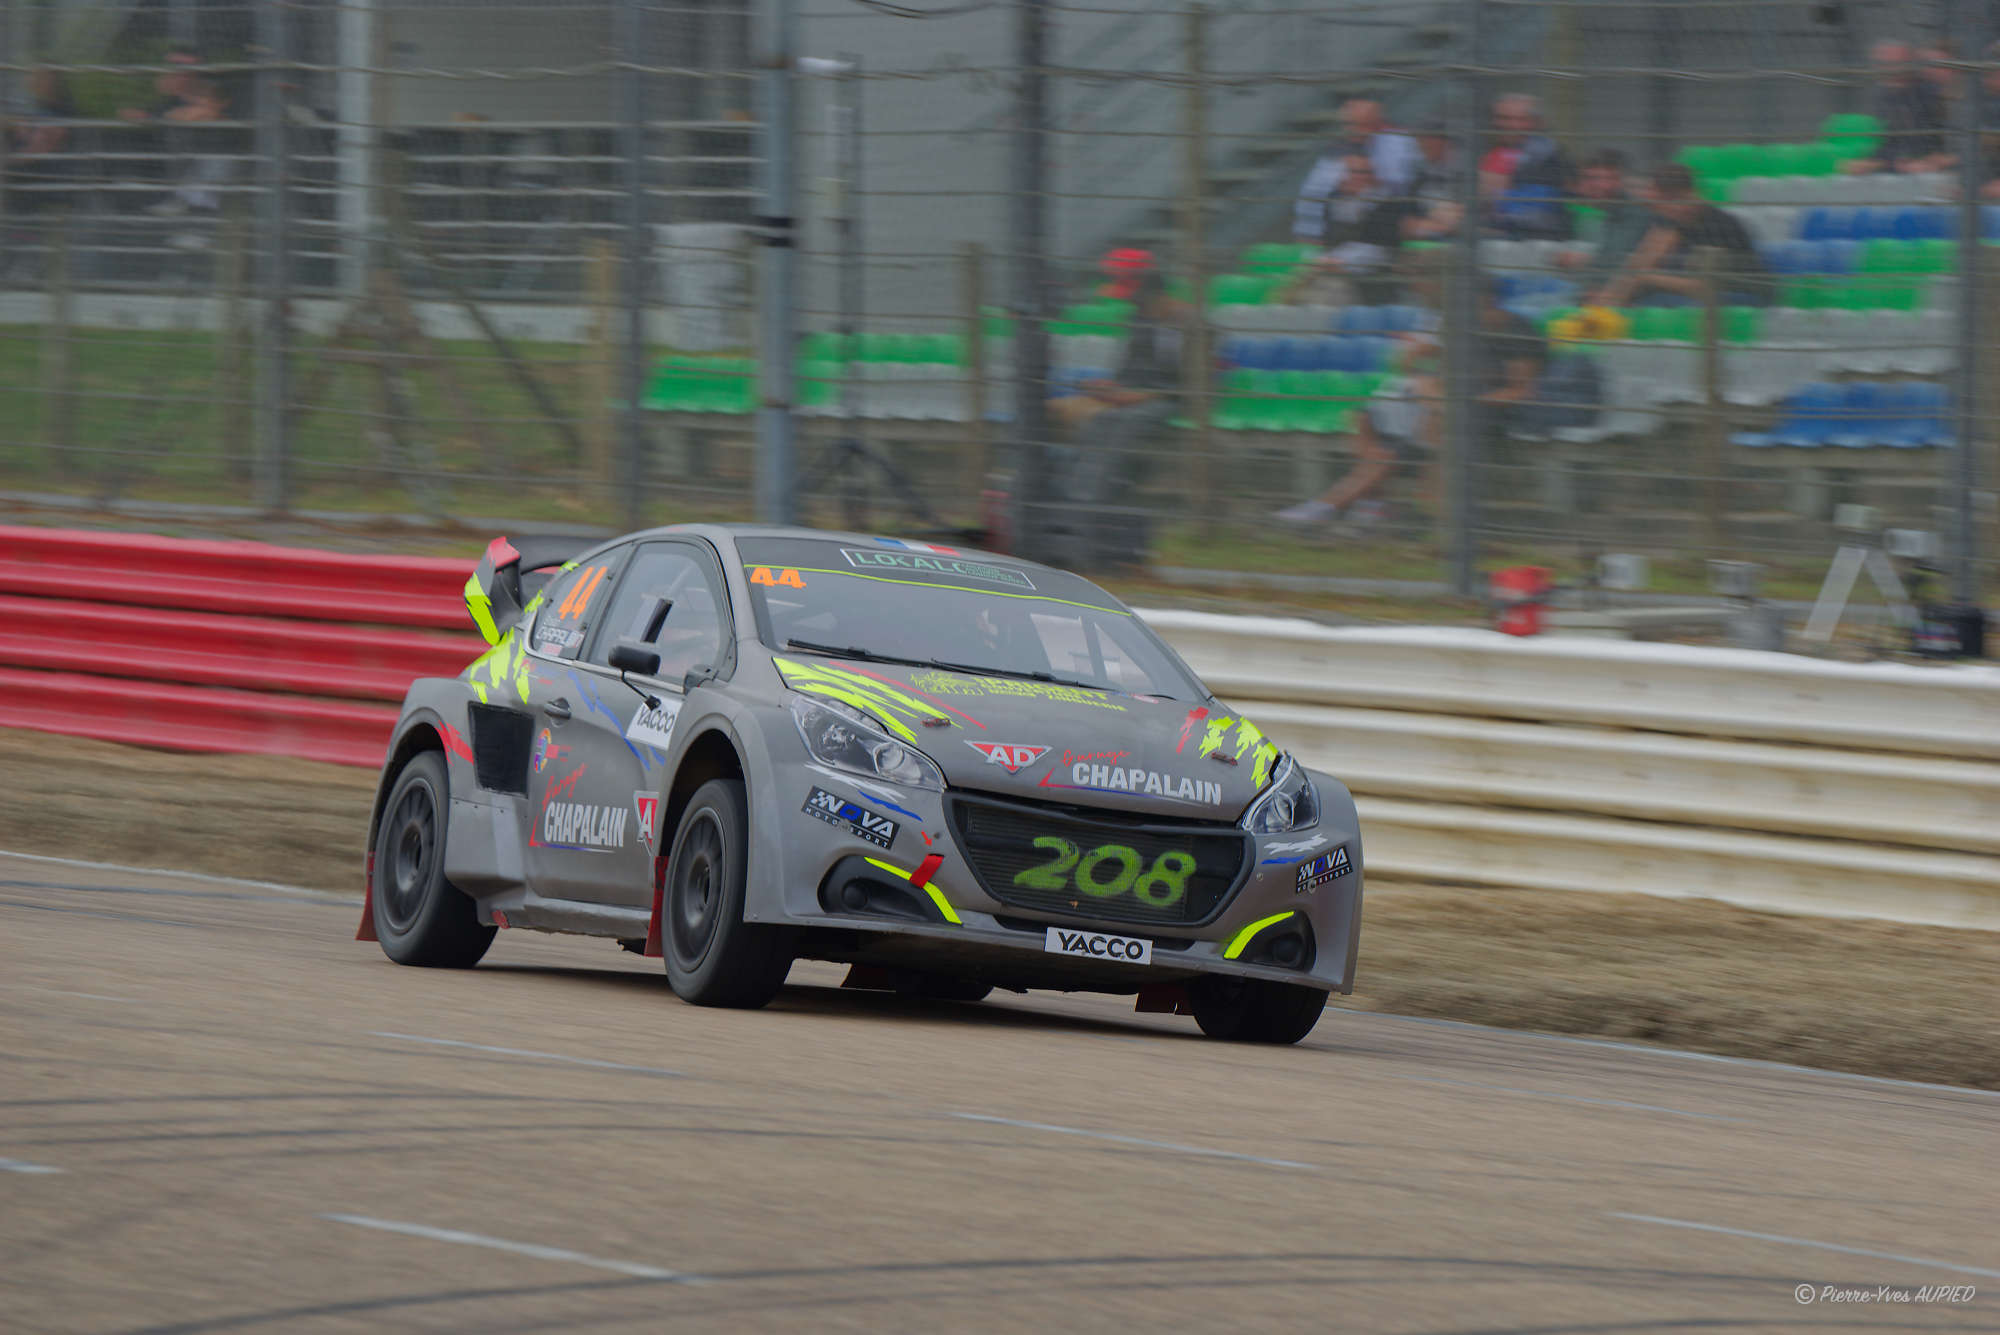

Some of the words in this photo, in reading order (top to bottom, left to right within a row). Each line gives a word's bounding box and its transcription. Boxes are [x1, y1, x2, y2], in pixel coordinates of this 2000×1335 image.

[558, 566, 608, 620] 44
[750, 567, 807, 588] 44
[636, 705, 675, 733] YACCO
[986, 746, 1036, 767] AD
[1072, 763, 1222, 805] CHAPALAIN
[544, 801, 628, 847] CHAPALAIN
[806, 807, 888, 848] MOTOSPORT
[1013, 836, 1197, 907] 208
[1058, 931, 1144, 960] YACCO
